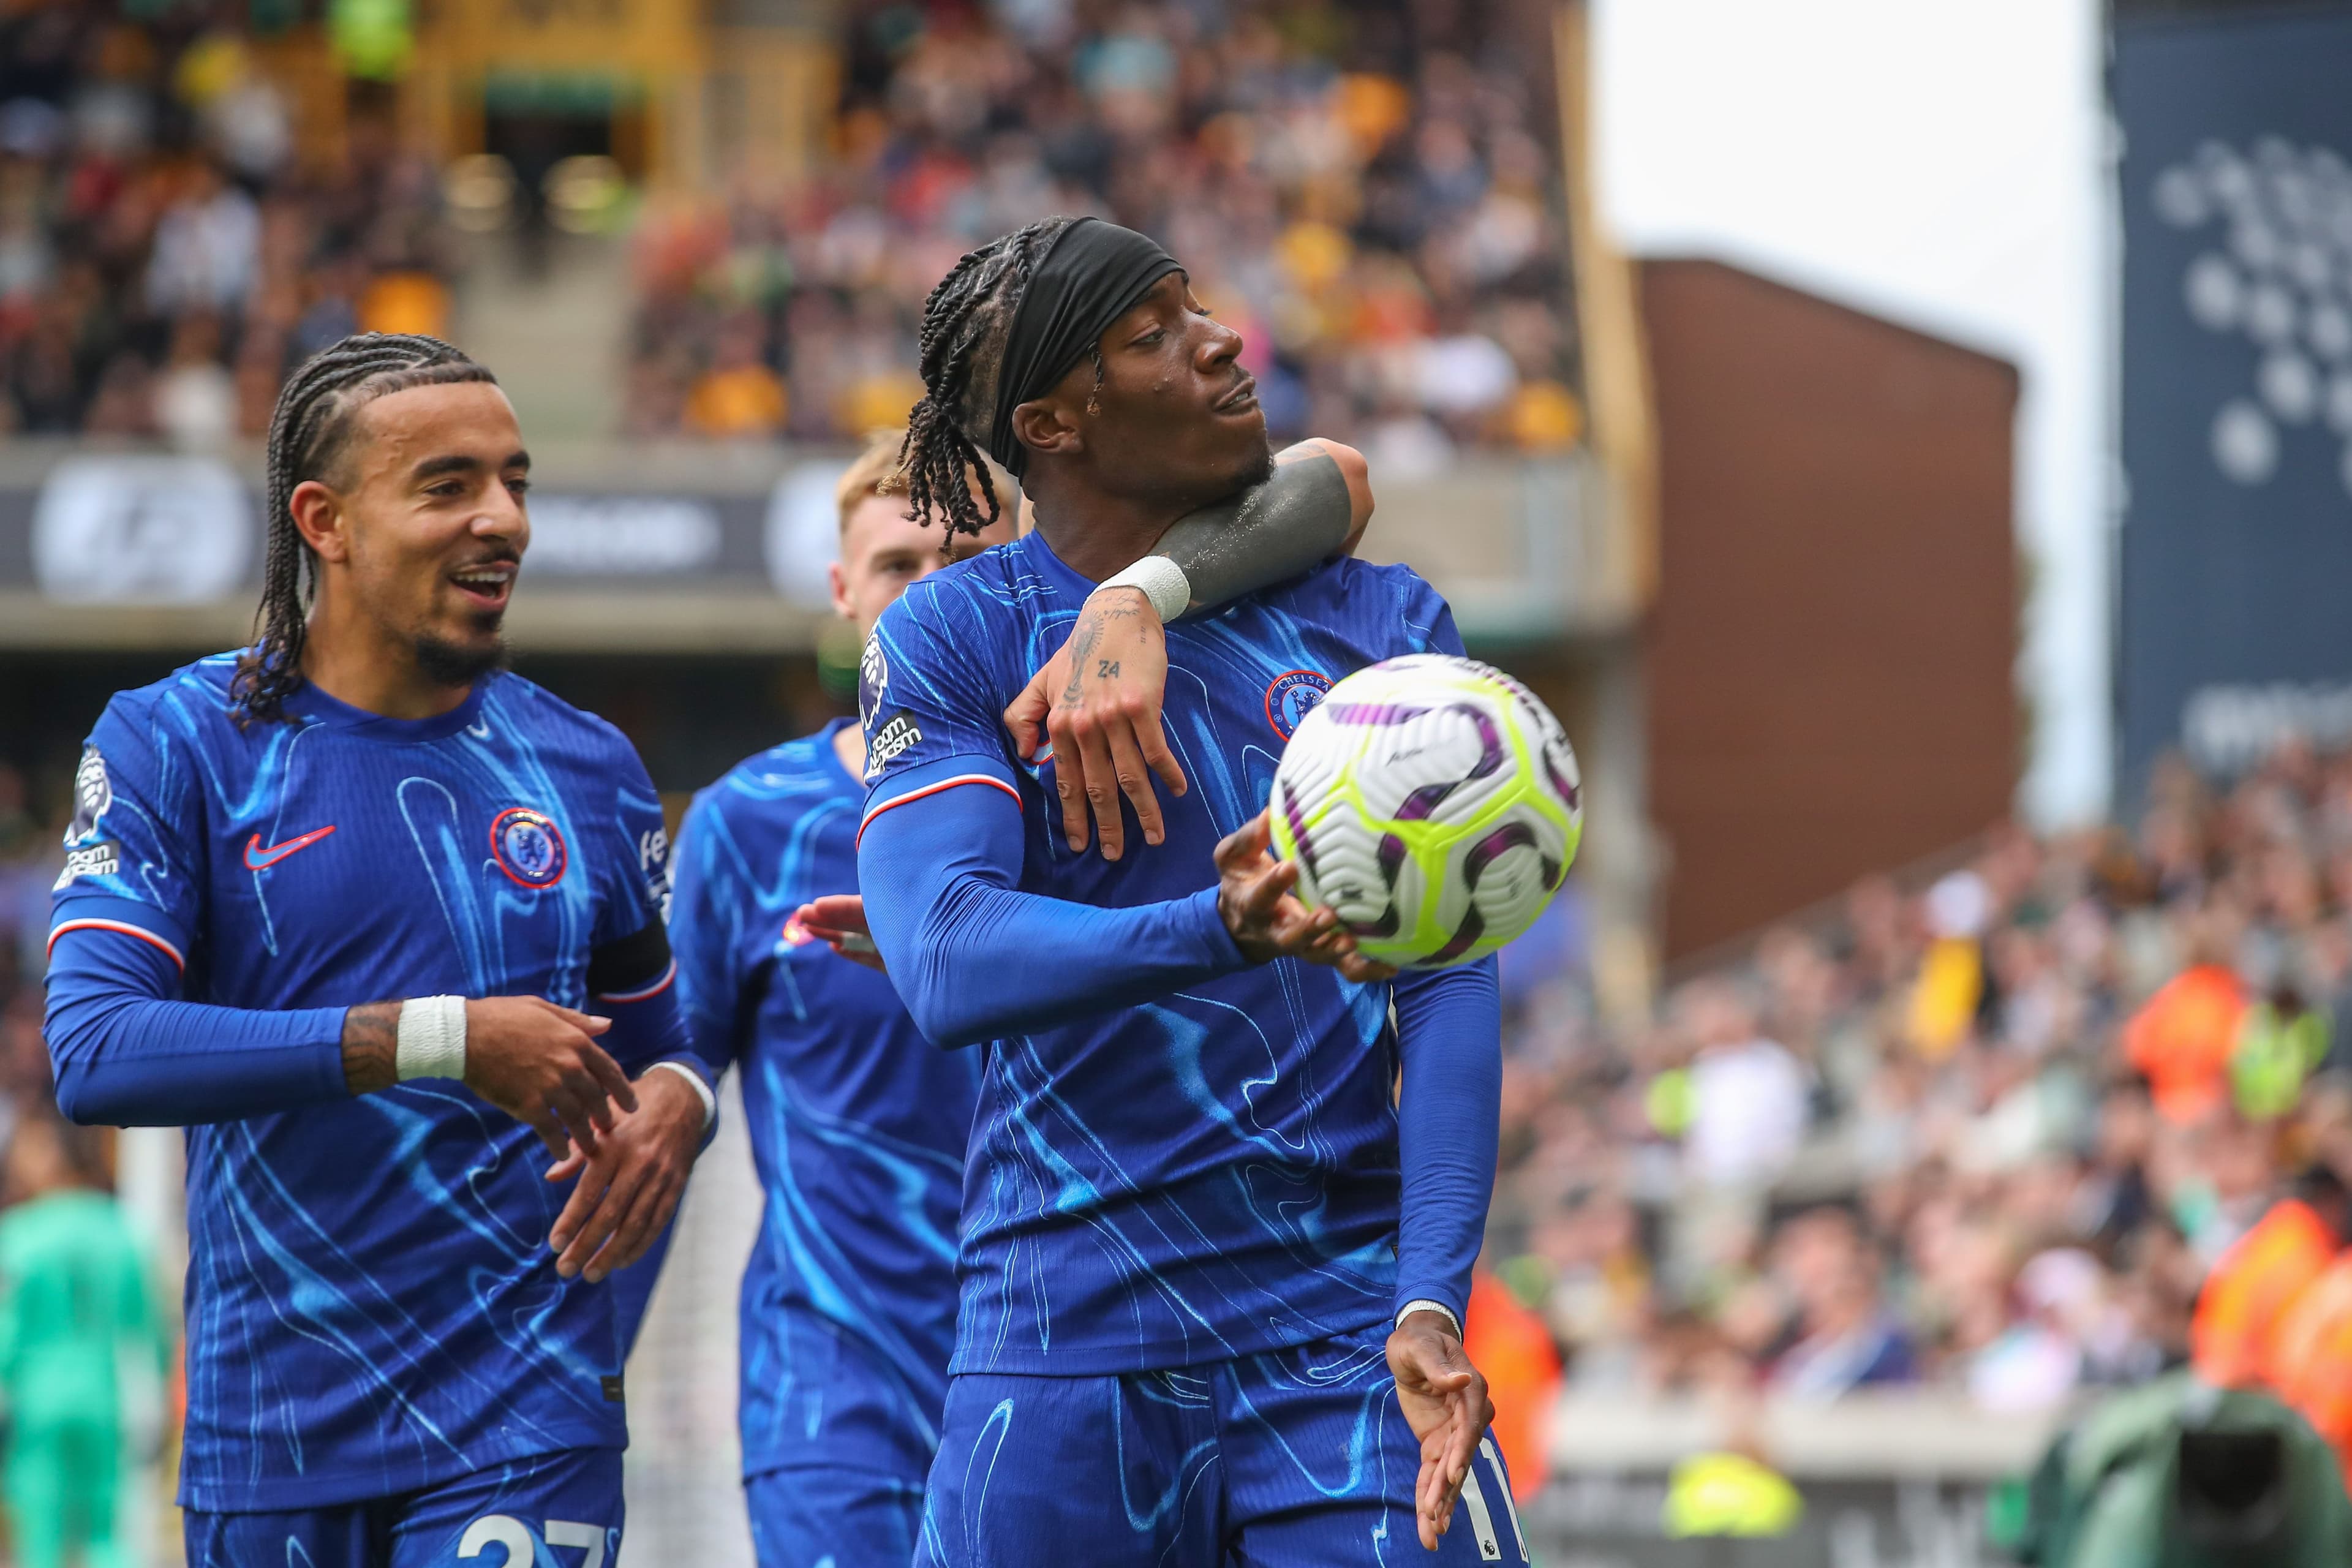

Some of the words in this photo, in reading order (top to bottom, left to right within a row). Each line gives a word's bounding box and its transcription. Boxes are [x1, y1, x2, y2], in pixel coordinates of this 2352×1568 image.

[1098, 659, 1120, 678] 24
[1278, 674, 1330, 692] CHELSEA
[1460, 1437, 1529, 1564] 11
